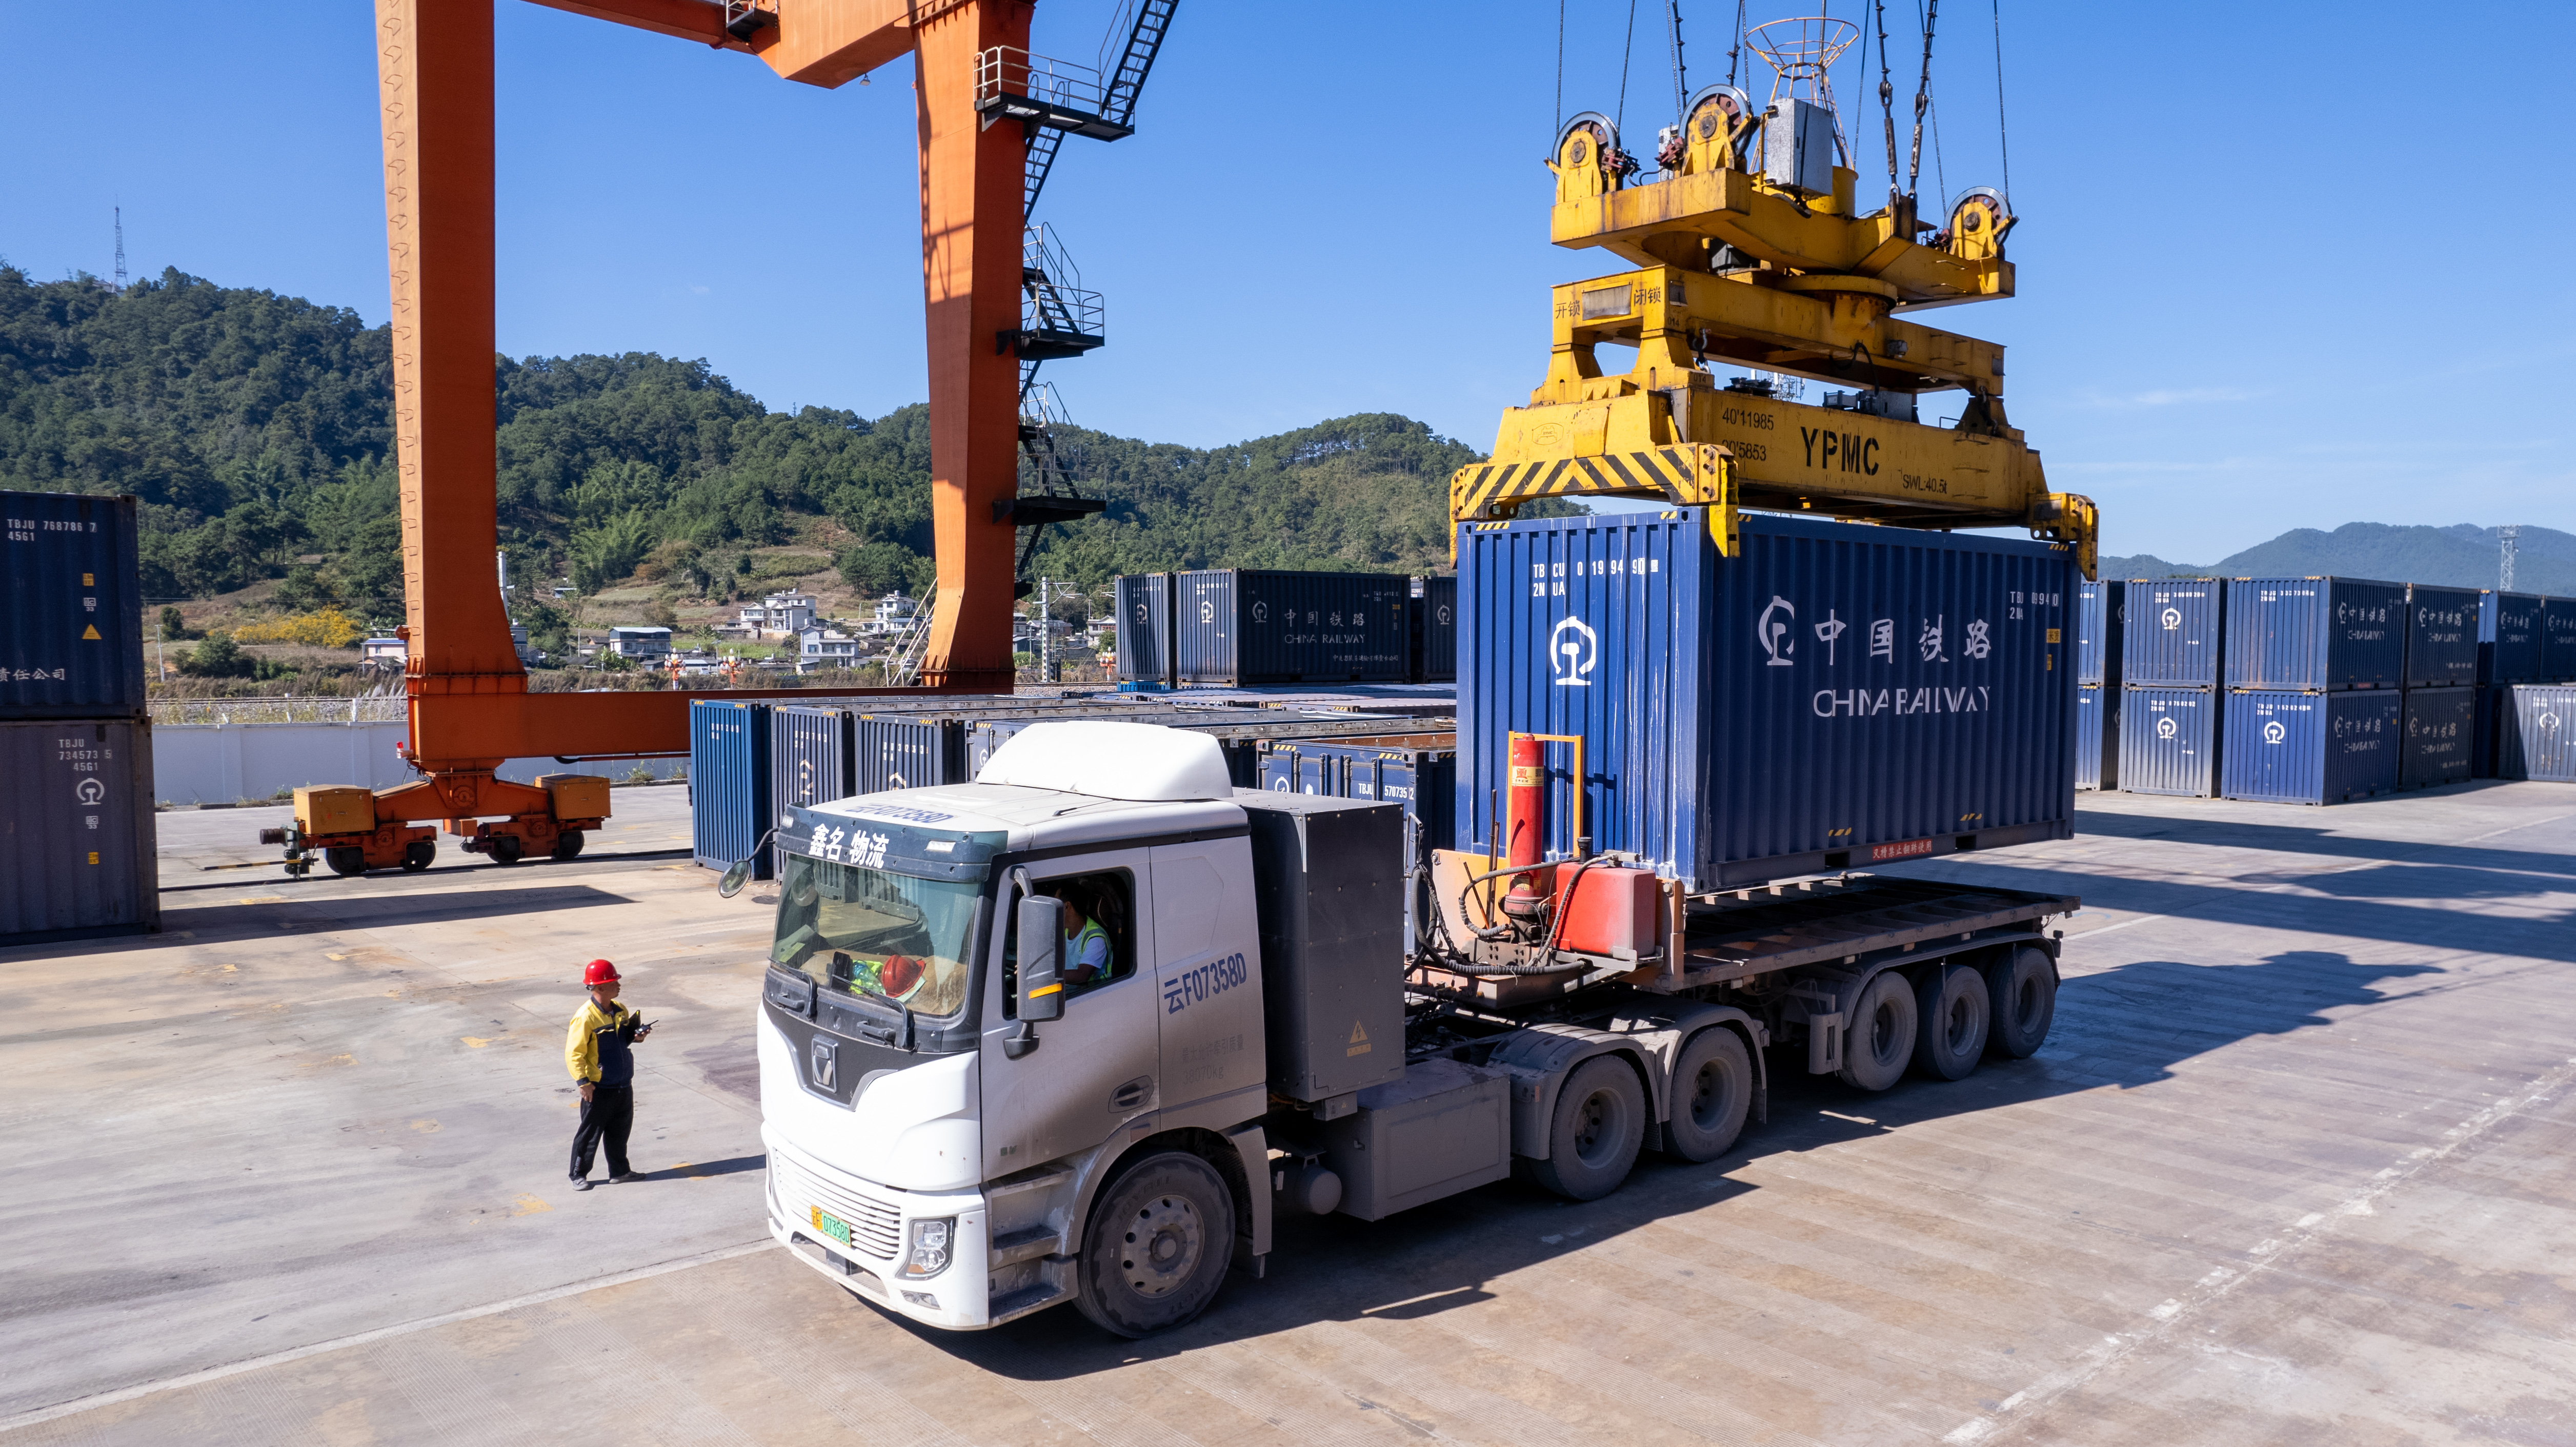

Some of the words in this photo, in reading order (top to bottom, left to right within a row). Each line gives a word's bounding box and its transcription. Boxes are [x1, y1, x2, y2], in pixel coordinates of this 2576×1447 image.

[1634, 286, 1661, 307] 闭锁
[1555, 299, 1580, 319] 开锁
[1667, 316, 1679, 327] 014
[1722, 407, 1774, 430] 40'11985
[1800, 426, 1880, 476] YPMC
[7, 519, 35, 529] TBJU
[43, 521, 83, 531] 768786
[1284, 609, 1365, 627] 中国铁路
[1284, 635, 1317, 644] CHINA
[1323, 635, 1365, 644] RAILWAY
[1815, 609, 1991, 665] 中国铁路
[1814, 689, 1889, 717] CHNA
[59, 739, 85, 748] TBJU
[59, 750, 98, 760] 734573
[73, 762, 98, 771] 45G1
[1359, 783, 1374, 795] TBJU
[1384, 785, 1407, 799] 570735
[809, 823, 844, 861] 鑫名
[849, 829, 890, 869] 物流
[1164, 952, 1247, 1015] 云F07358D
